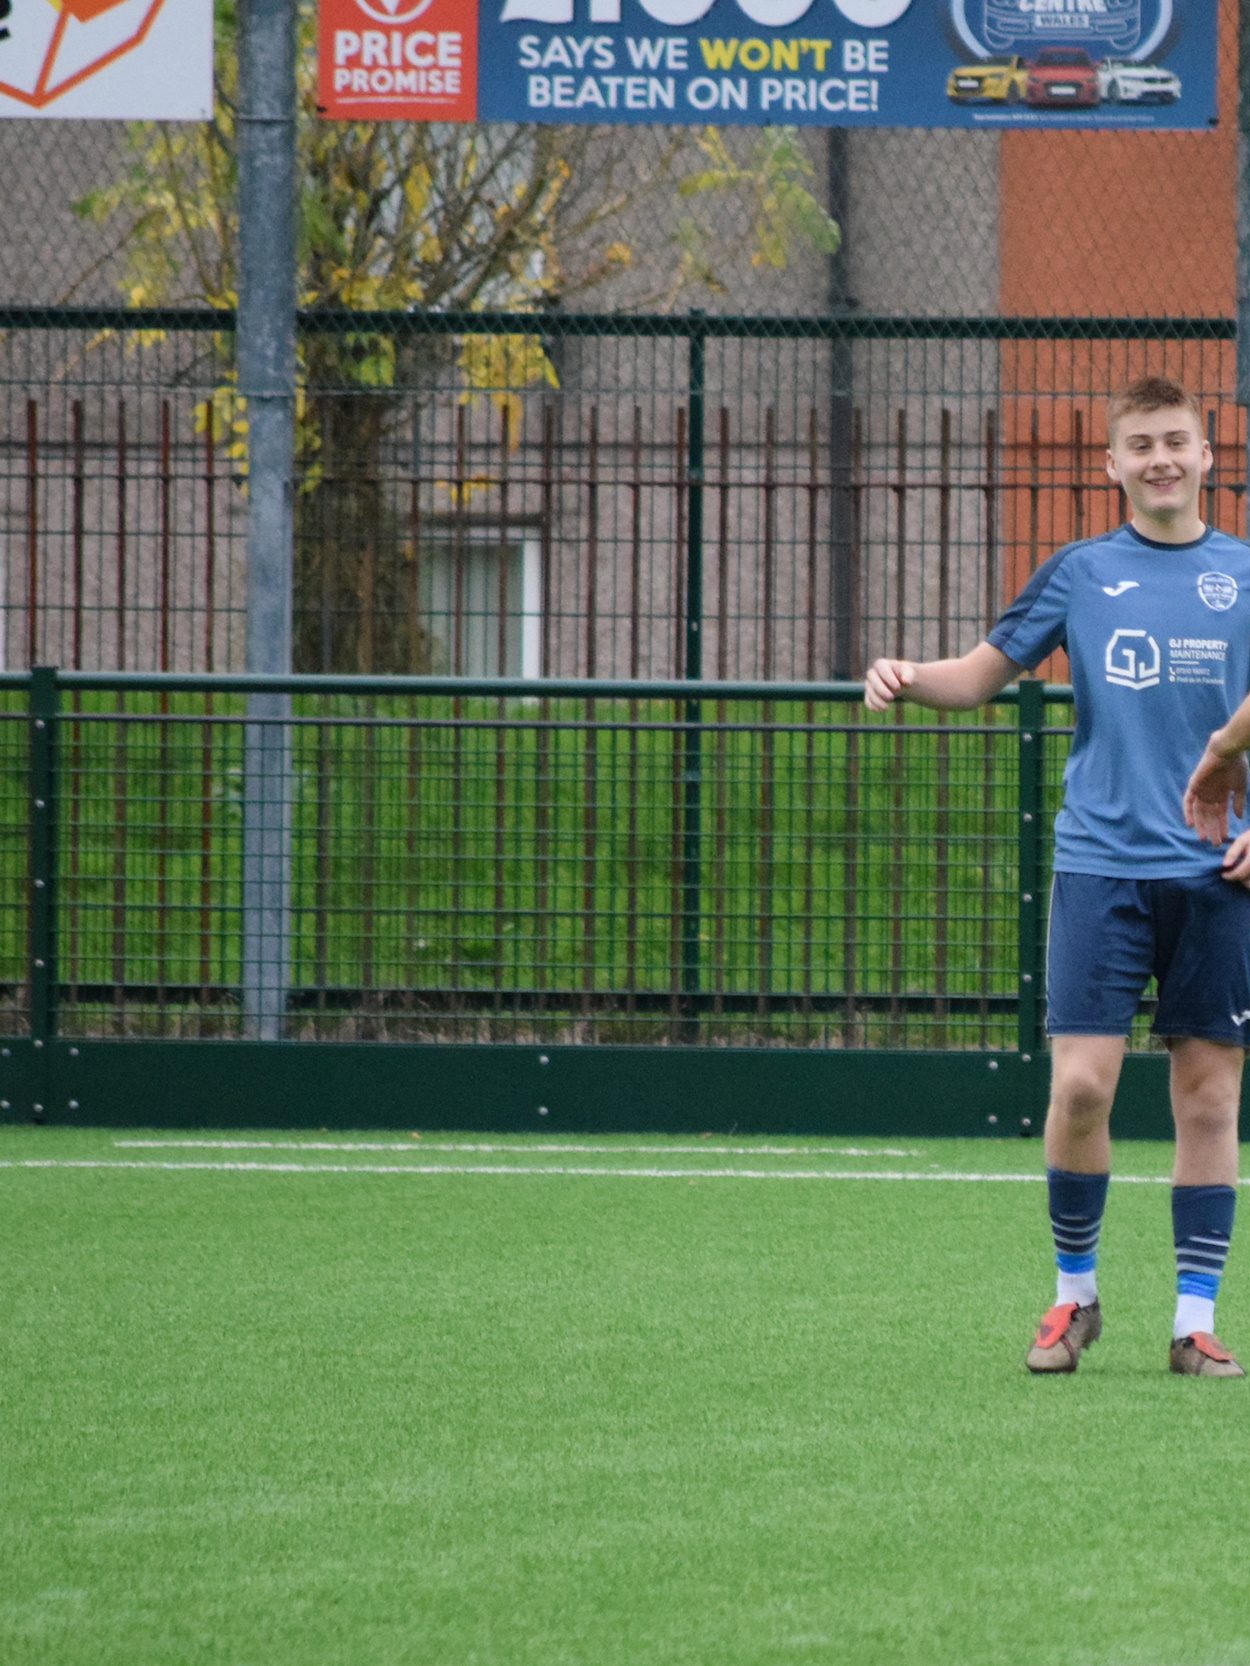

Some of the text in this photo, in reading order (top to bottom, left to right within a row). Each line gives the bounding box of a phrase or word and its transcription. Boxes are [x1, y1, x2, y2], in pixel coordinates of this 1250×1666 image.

[334, 30, 462, 67] PRICE
[518, 35, 889, 73] SAYS WE WON'T BE
[334, 68, 461, 94] PROMISE
[527, 75, 879, 112] BEATEN ON PRICE!
[1169, 637, 1229, 651] GJ PROPERTY
[1170, 649, 1227, 661] MAINTENANCE
